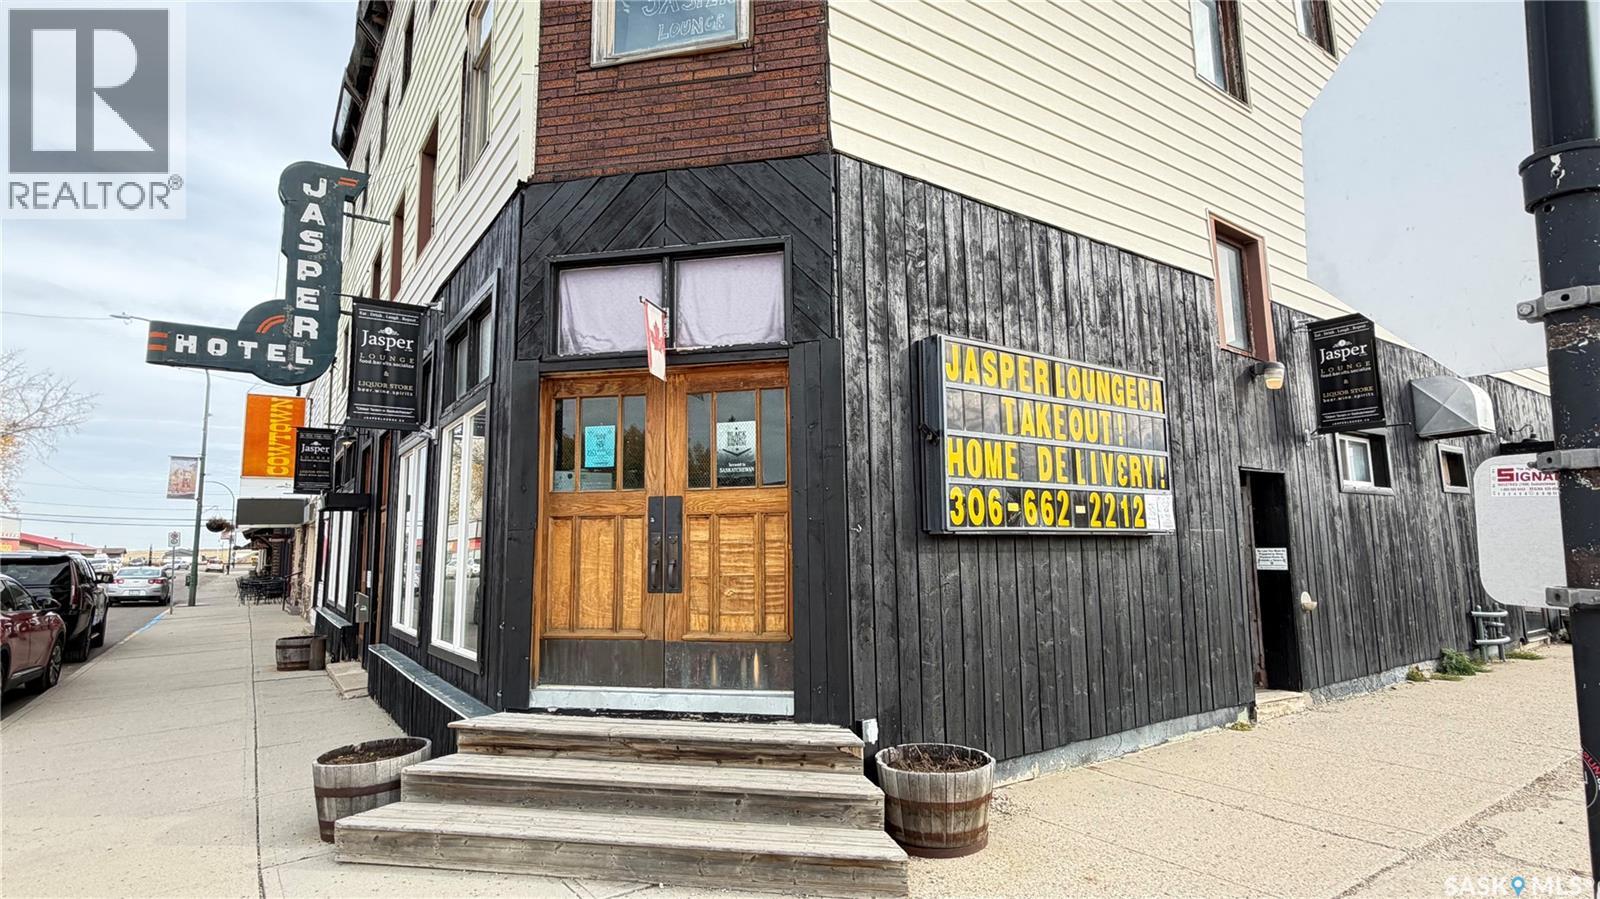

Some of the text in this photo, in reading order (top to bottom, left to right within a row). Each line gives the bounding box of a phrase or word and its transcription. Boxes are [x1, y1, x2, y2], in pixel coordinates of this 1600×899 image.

[657, 13, 726, 41] LOUNGE
[293, 177, 328, 340] JASPER
[174, 333, 314, 366] HOTEL
[361, 329, 415, 352] Jasper
[360, 352, 415, 364] LOUNGE
[1320, 344, 1368, 365] Jasper
[1320, 360, 1372, 374] LOUNGE
[358, 380, 414, 391] LIQUOR STORE
[1322, 385, 1374, 399] LIQUOR STORE
[1001, 396, 1124, 446] TAKEOUT!
[266, 396, 294, 476] COWTOWN
[301, 443, 330, 455] Jasper
[947, 437, 1020, 480] HOME
[949, 486, 1146, 528] 306-662-2212
